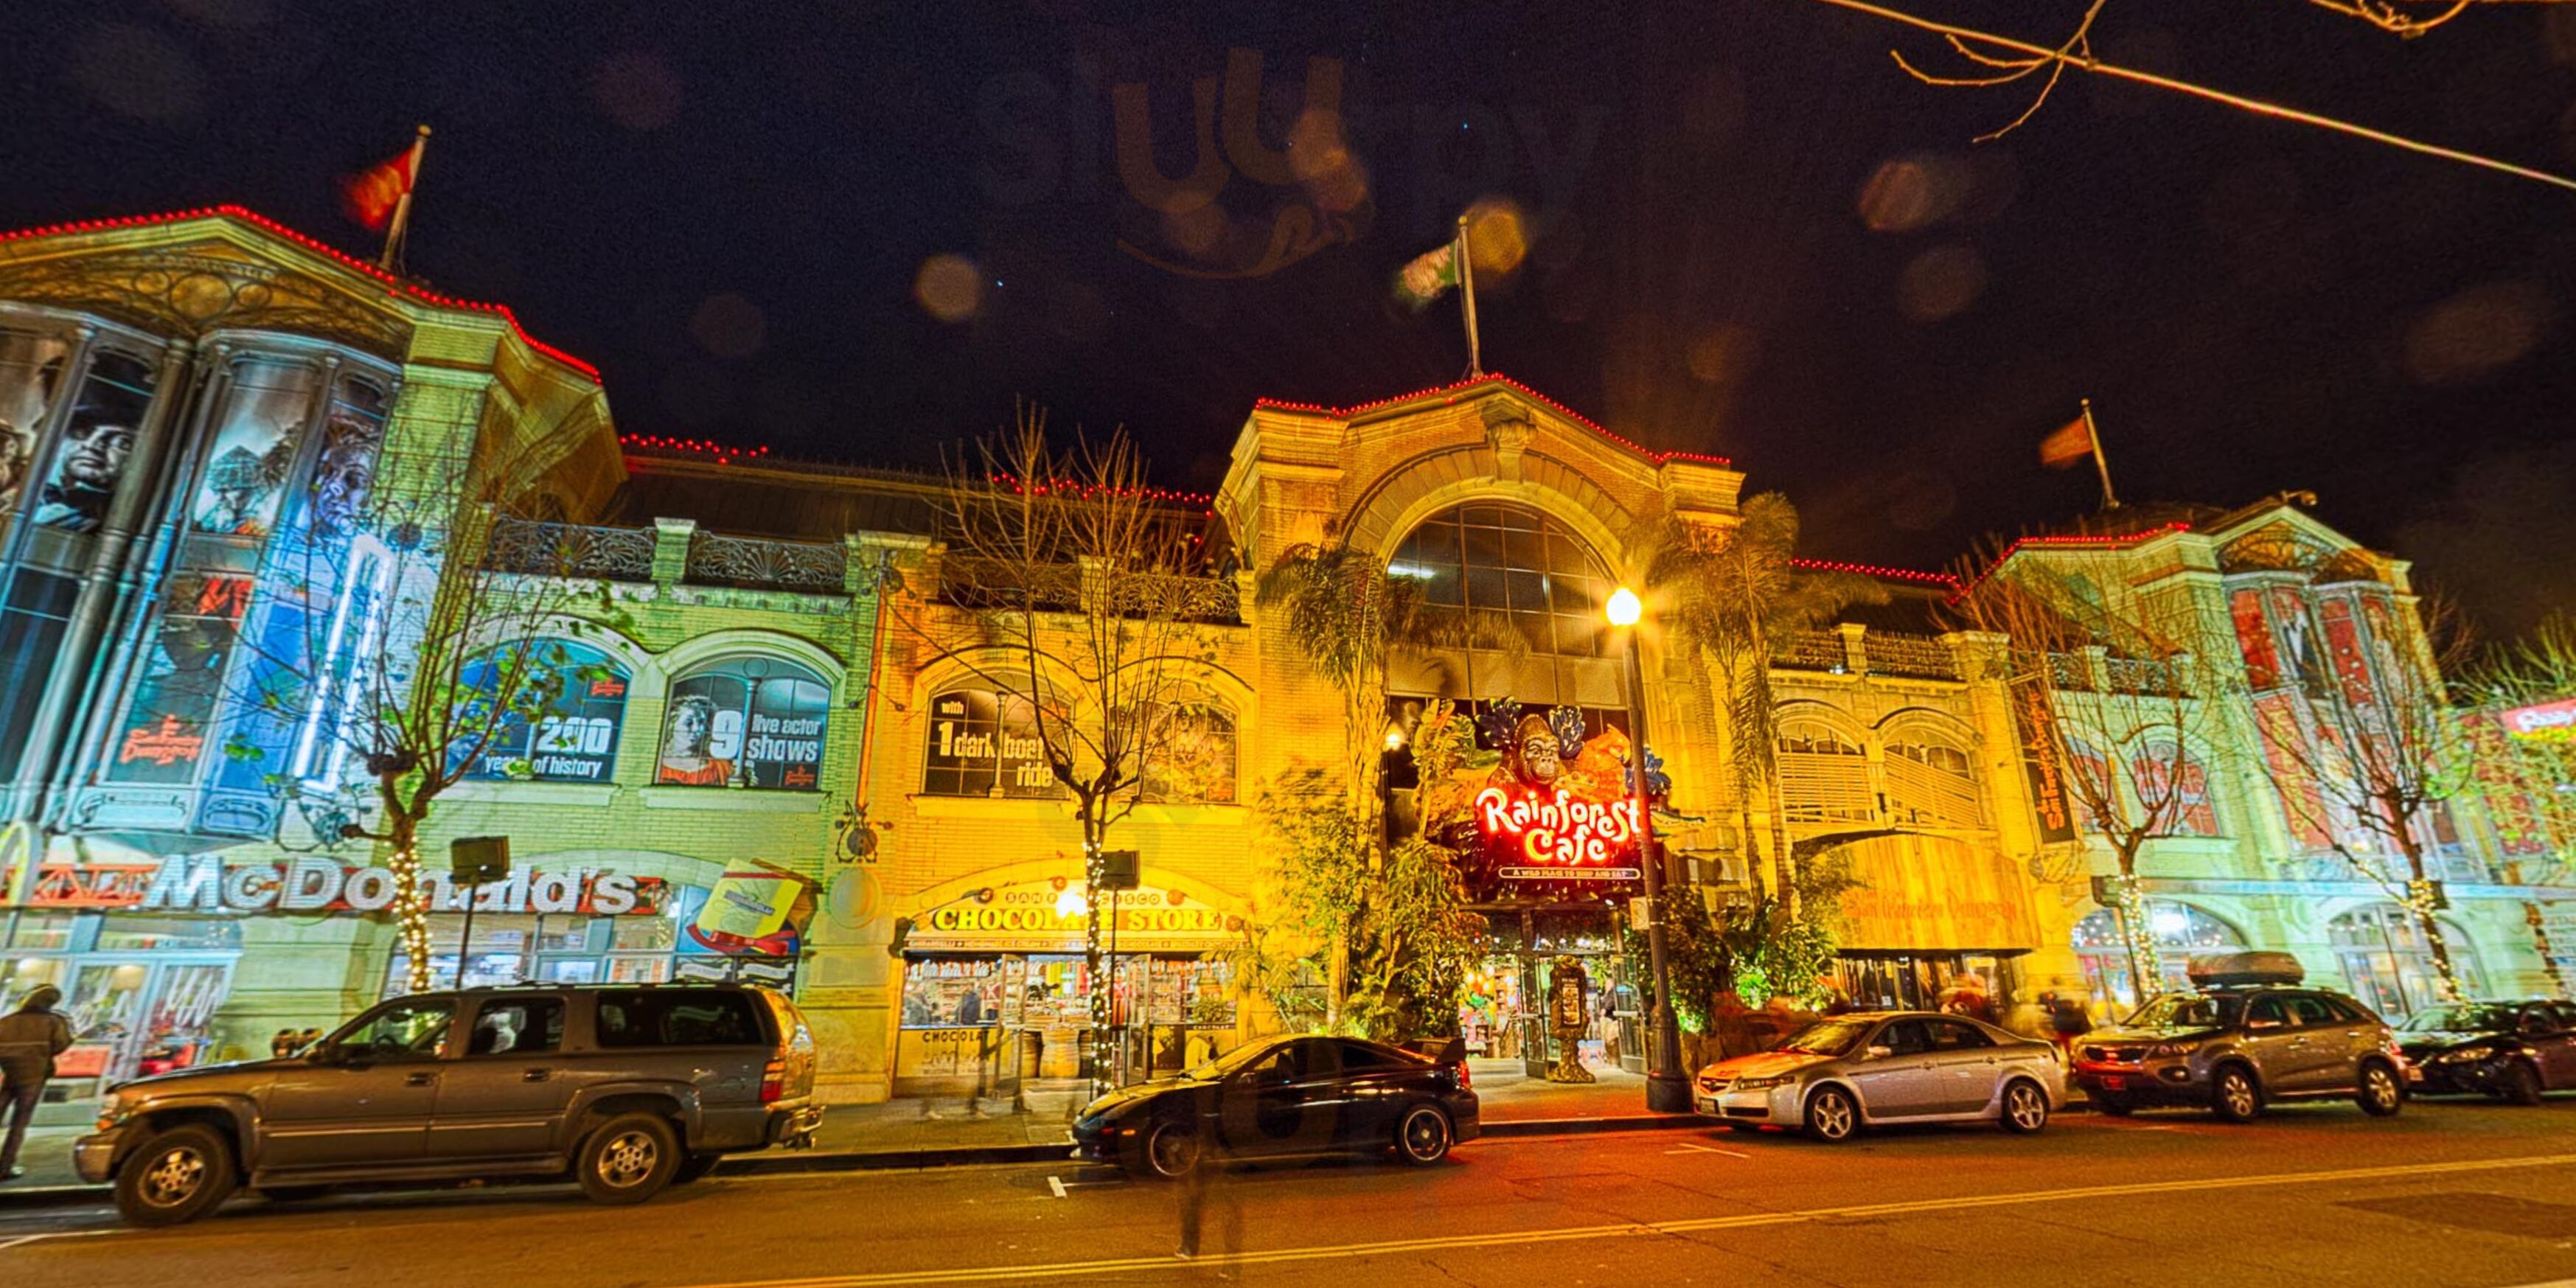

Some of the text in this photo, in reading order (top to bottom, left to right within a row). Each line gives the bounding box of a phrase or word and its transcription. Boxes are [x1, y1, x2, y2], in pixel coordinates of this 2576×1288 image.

[941, 701, 964, 715] with
[536, 715, 613, 754] 200
[709, 710, 743, 759] 9
[751, 713, 821, 736] live actor
[746, 735, 819, 762] shows
[939, 722, 954, 756] 1
[954, 731, 997, 759] dark
[532, 756, 549, 773] of
[549, 756, 603, 779] history
[1017, 761, 1054, 788] ride
[1476, 787, 1642, 842] Rainforest
[1525, 824, 1607, 866] Cafe
[1005, 892, 1042, 905] SAN
[1128, 908, 1222, 931] STORE
